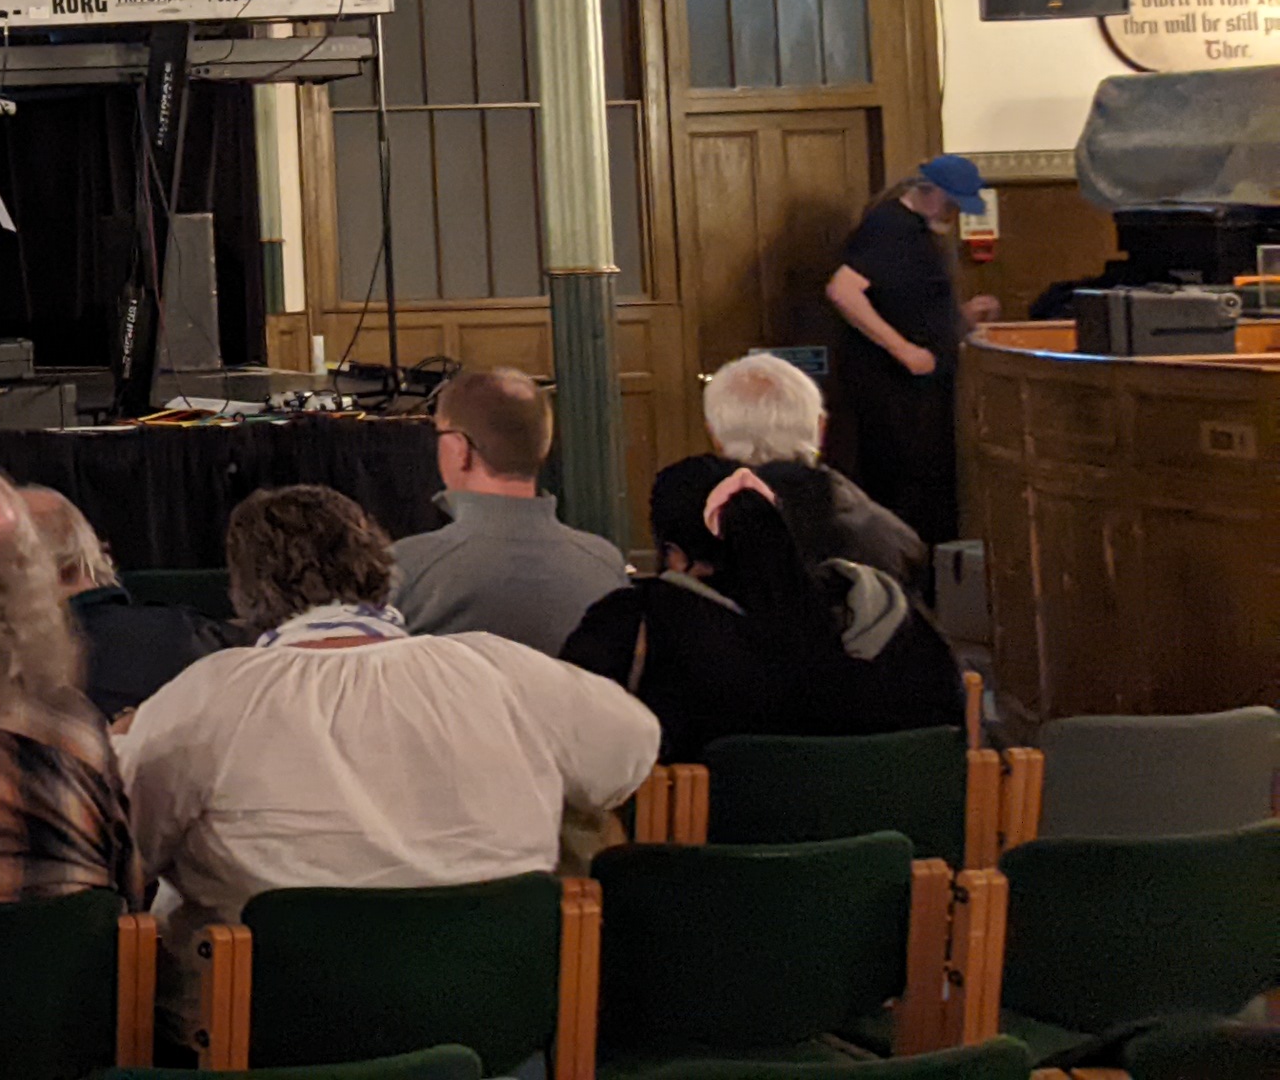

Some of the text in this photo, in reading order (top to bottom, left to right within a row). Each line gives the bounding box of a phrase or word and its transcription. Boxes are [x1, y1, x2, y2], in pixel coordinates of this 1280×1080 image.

[1165, 12, 1196, 33] will
[1202, 13, 1221, 33] be
[1226, 11, 1259, 32] still
